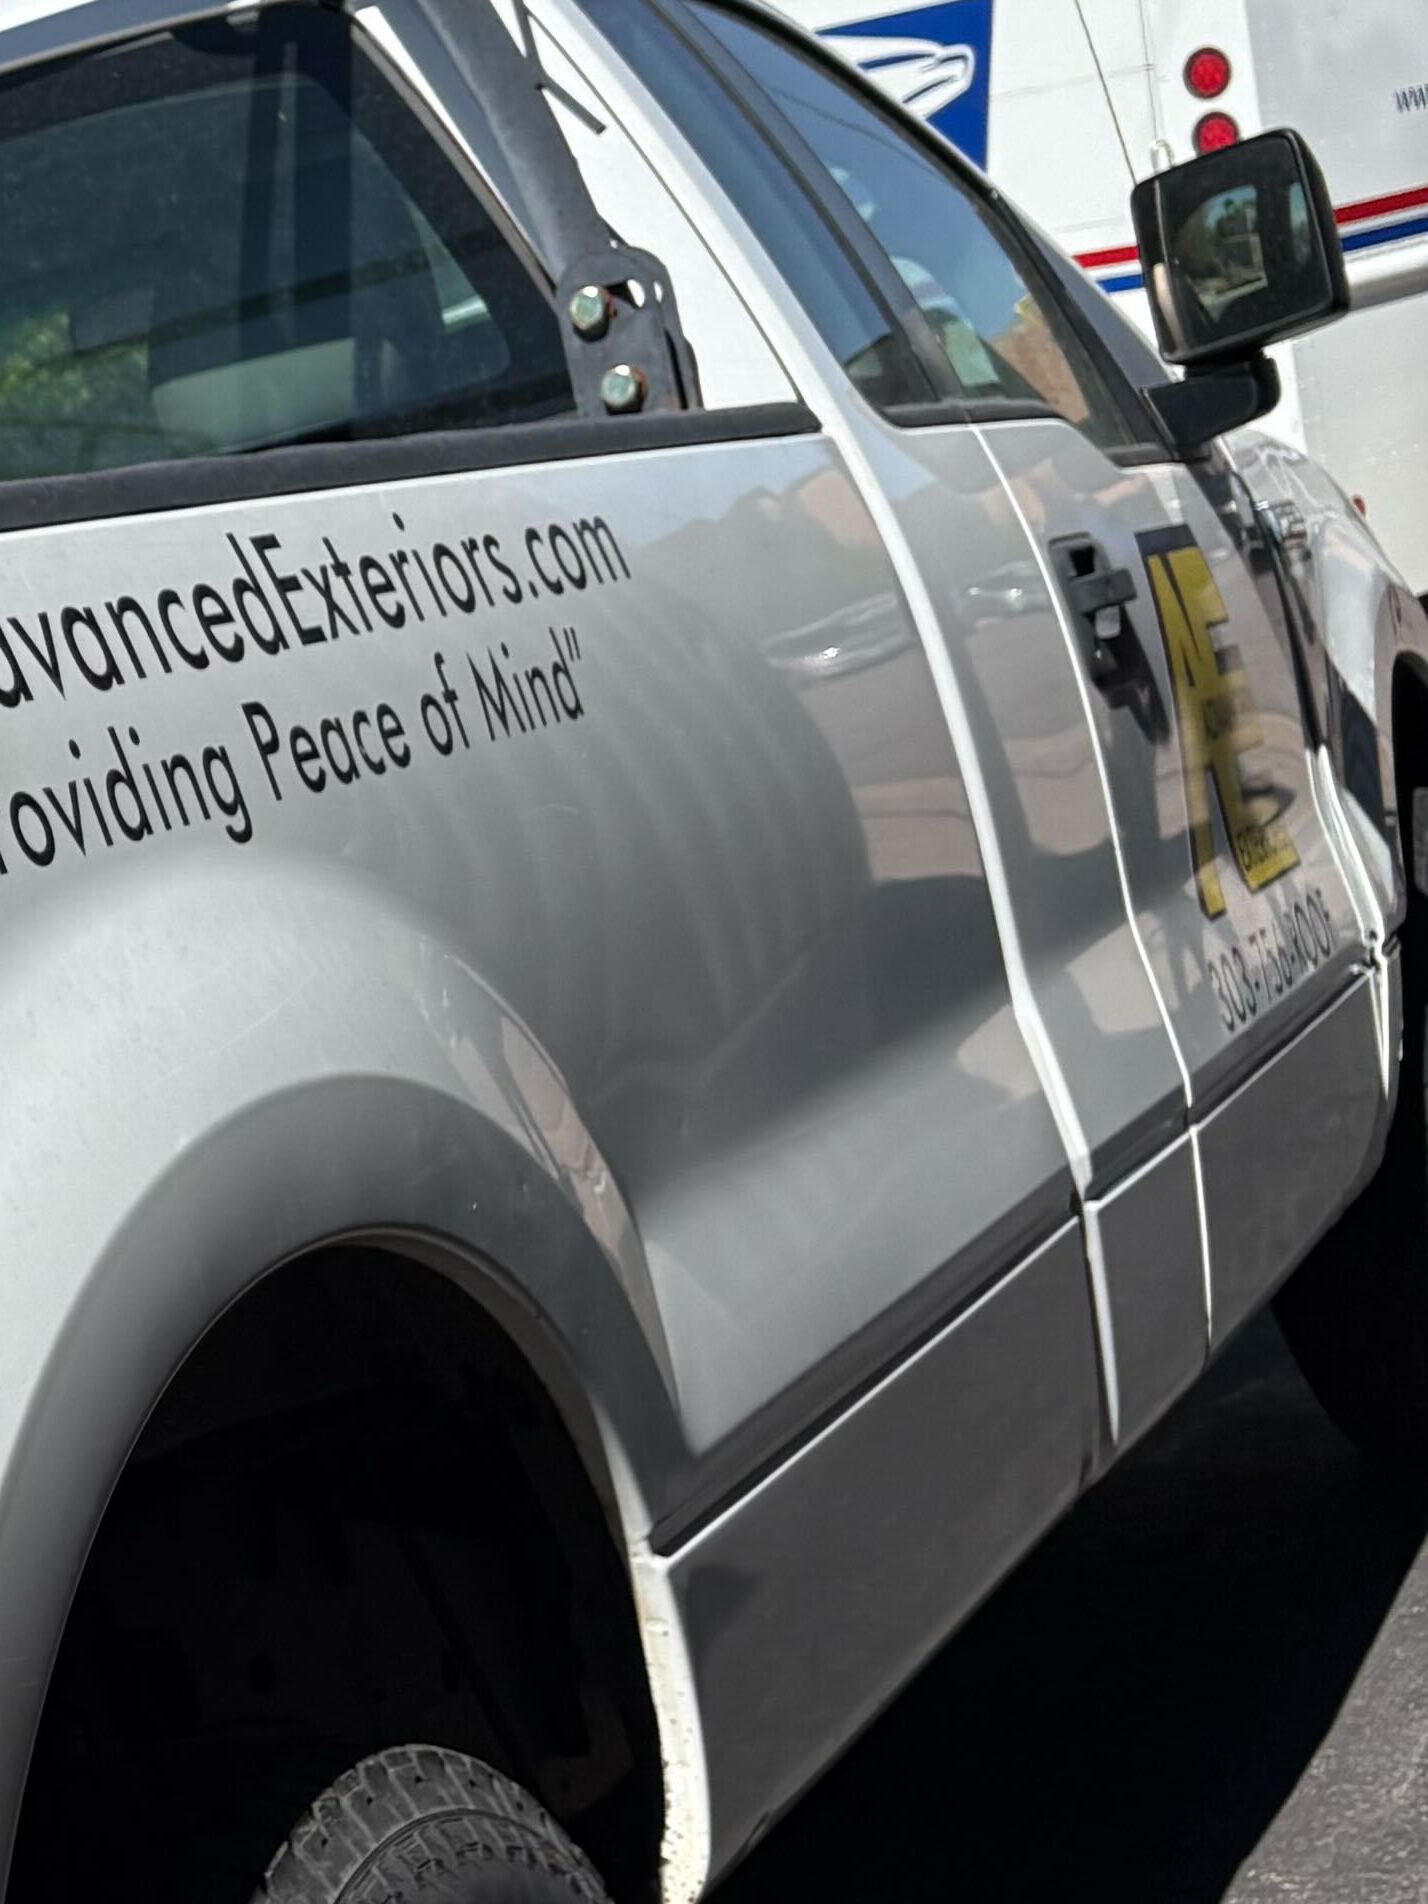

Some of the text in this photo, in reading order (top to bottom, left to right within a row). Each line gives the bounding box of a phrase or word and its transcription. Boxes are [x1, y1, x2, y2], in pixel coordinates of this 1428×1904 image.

[241, 700, 411, 801] Peace
[420, 651, 470, 757] of
[466, 625, 584, 742] Mind"
